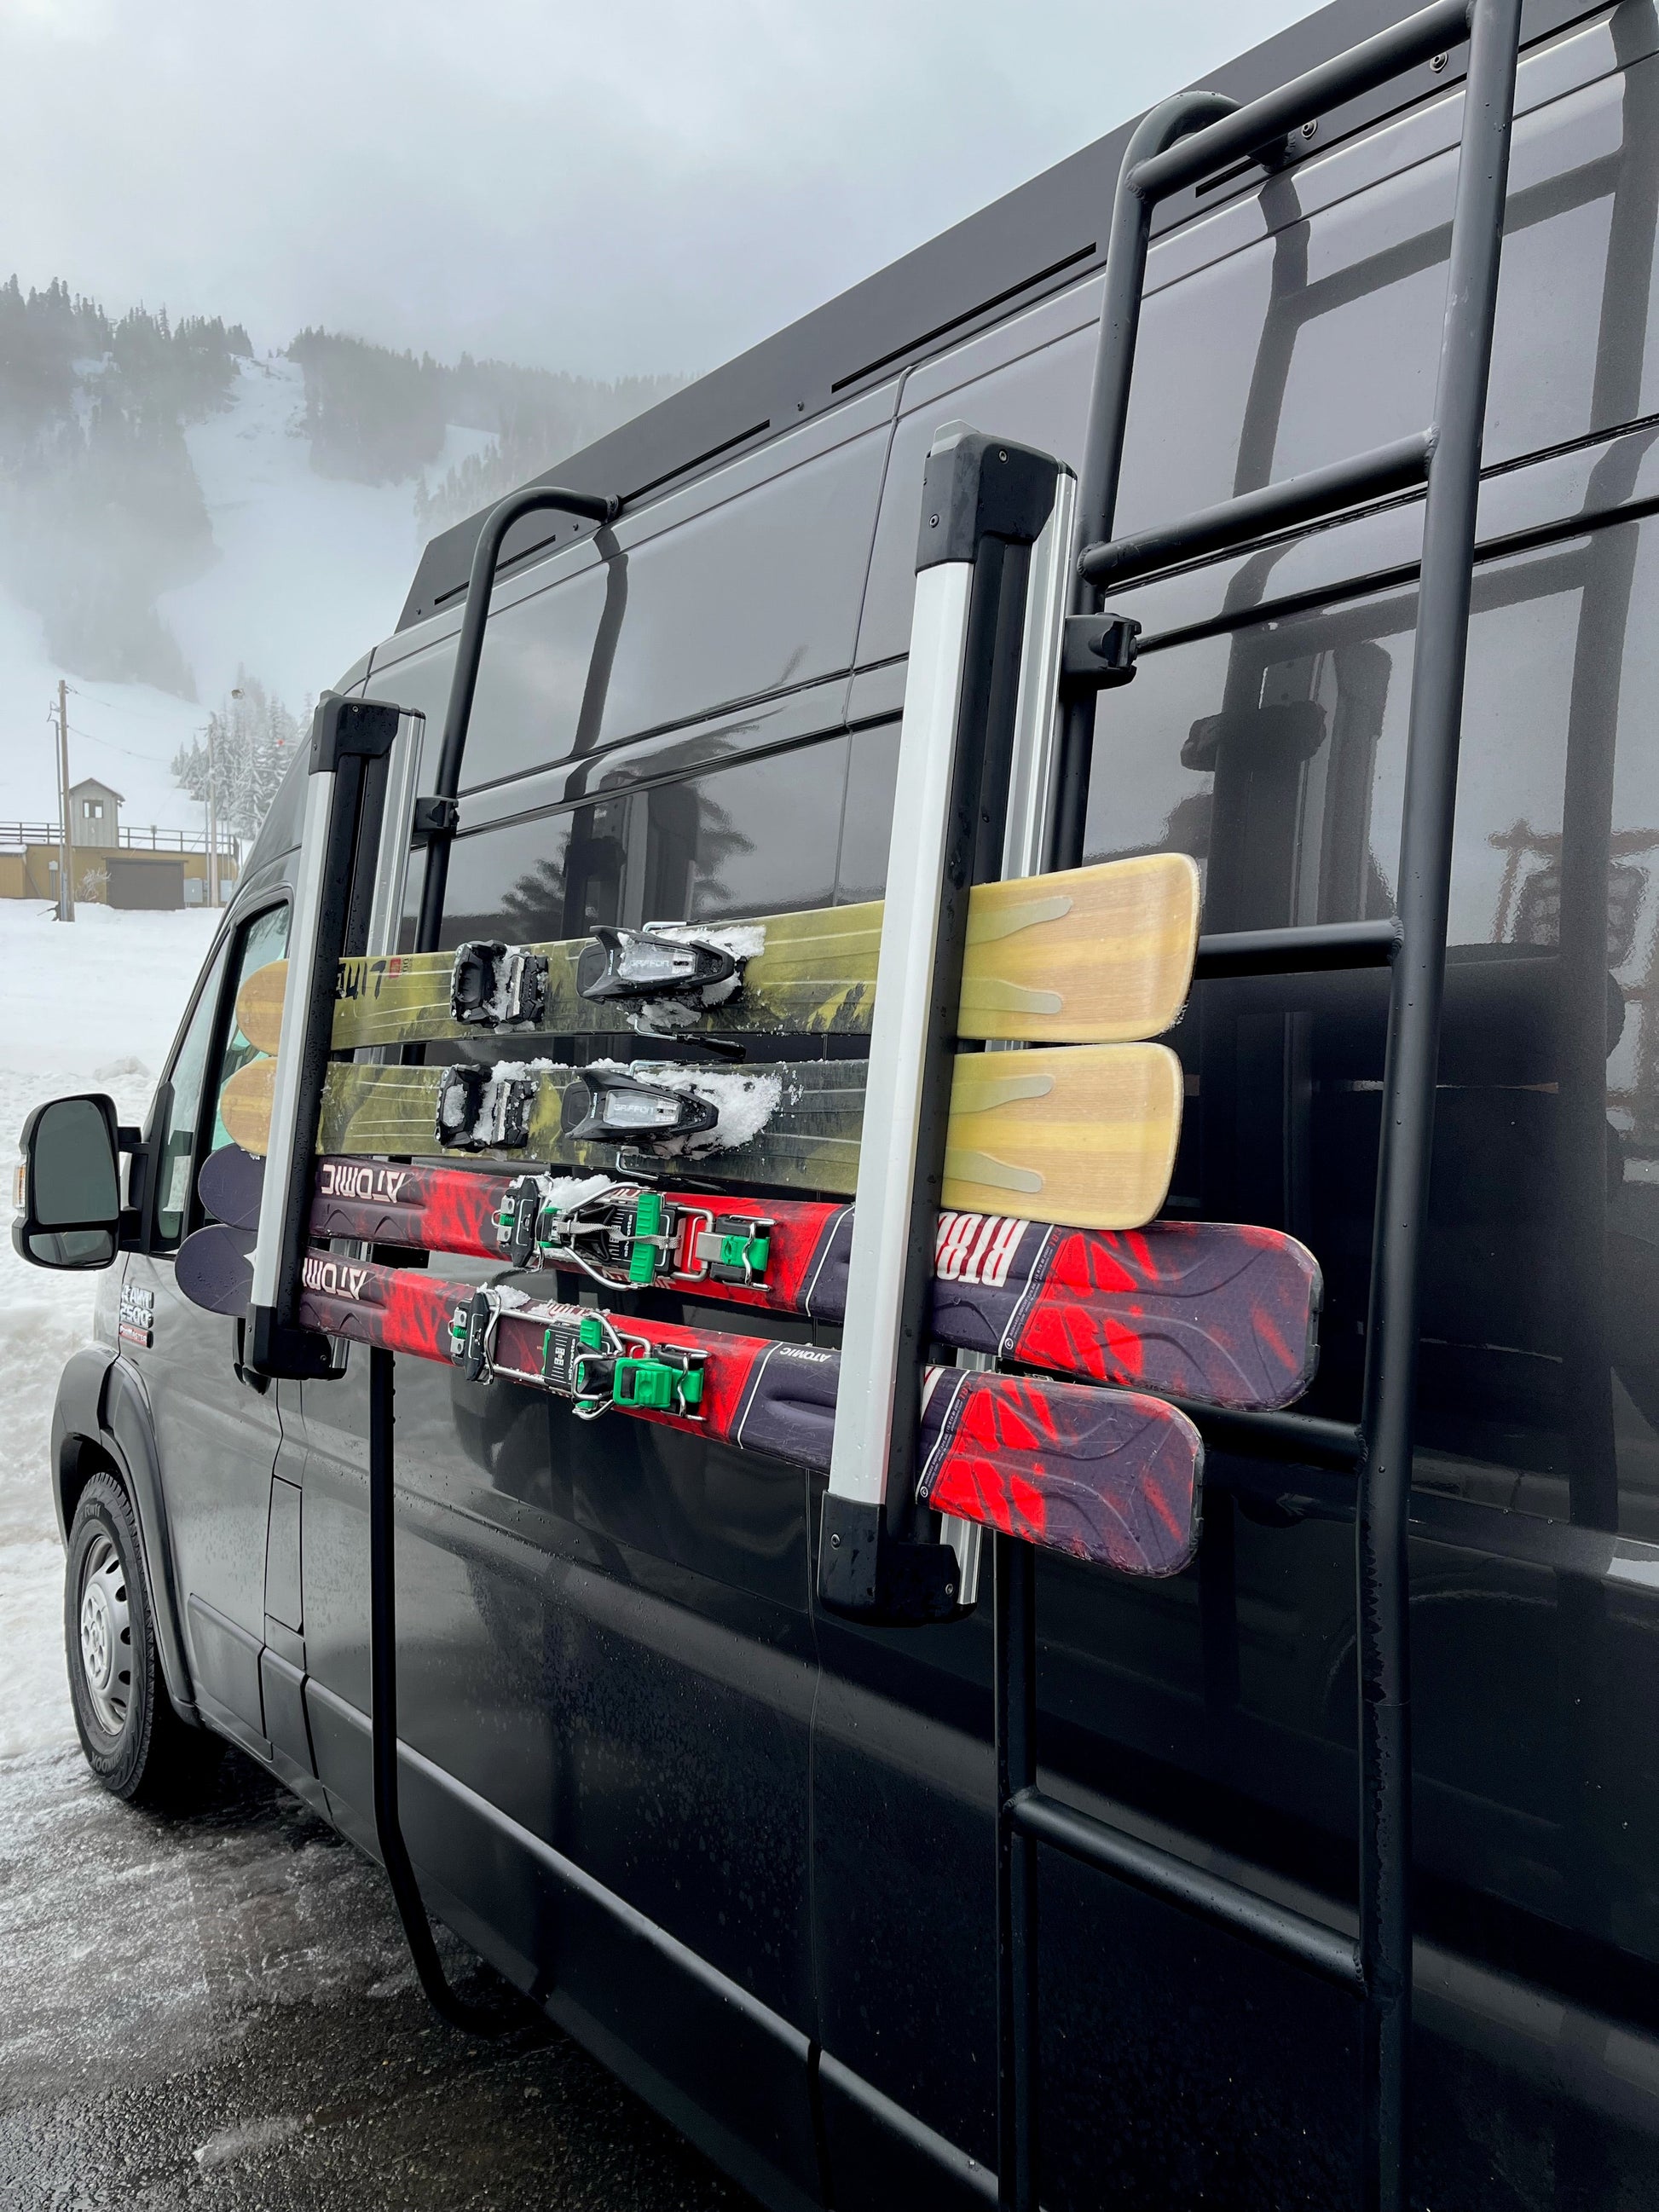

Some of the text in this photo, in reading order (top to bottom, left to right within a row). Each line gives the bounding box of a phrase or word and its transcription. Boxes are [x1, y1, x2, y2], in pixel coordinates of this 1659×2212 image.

[321, 1164, 406, 1204] ATOMIC
[624, 1214, 633, 1257] silvetta
[302, 1257, 367, 1301] ATOMI
[778, 1346, 833, 1363] ATOMIC
